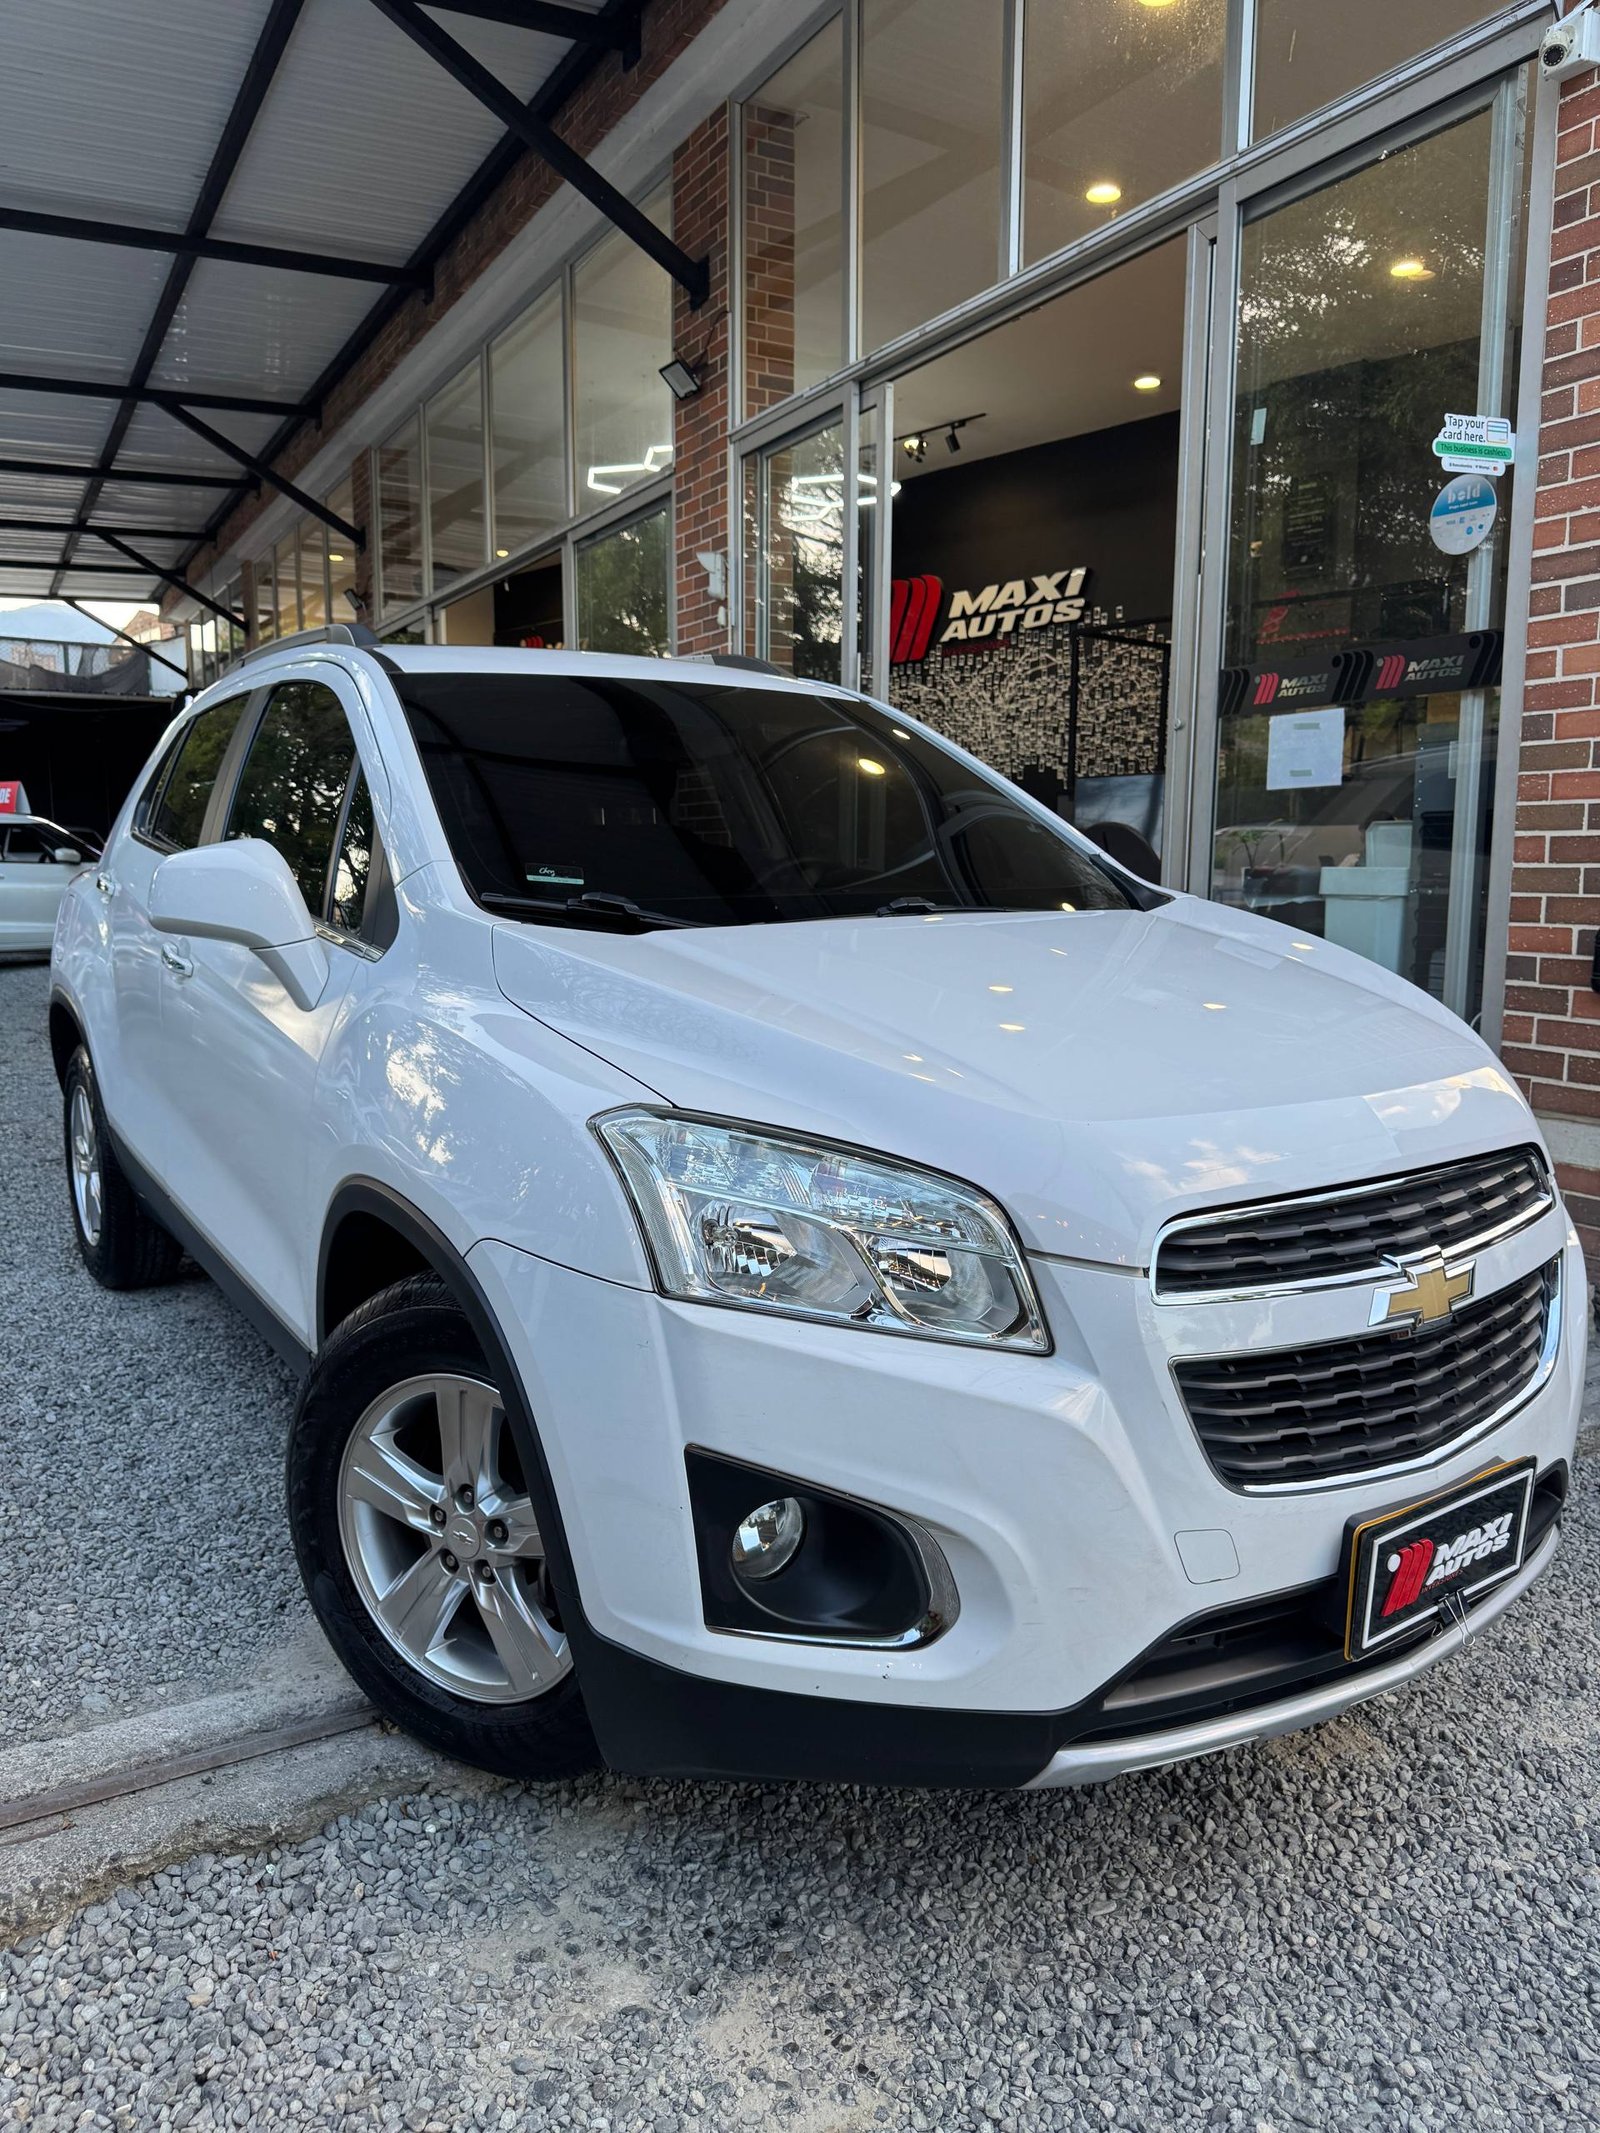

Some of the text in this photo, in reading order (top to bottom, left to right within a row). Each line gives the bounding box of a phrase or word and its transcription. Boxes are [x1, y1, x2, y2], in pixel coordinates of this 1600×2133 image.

[1447, 415, 1485, 430] Tap your
[1443, 430, 1486, 443] card here.
[1440, 443, 1453, 452] This
[1453, 444, 1477, 454] business
[1477, 446, 1483, 455] is
[948, 566, 1087, 619] MAXI
[938, 598, 1086, 643] AUTOS
[1406, 655, 1465, 672] MAXI
[1280, 673, 1329, 689] MAXI
[1403, 667, 1462, 682] AUTOS
[1277, 684, 1327, 698] AUTOS
[1432, 1512, 1514, 1567] MAXI
[1425, 1532, 1511, 1586] AUTOS
